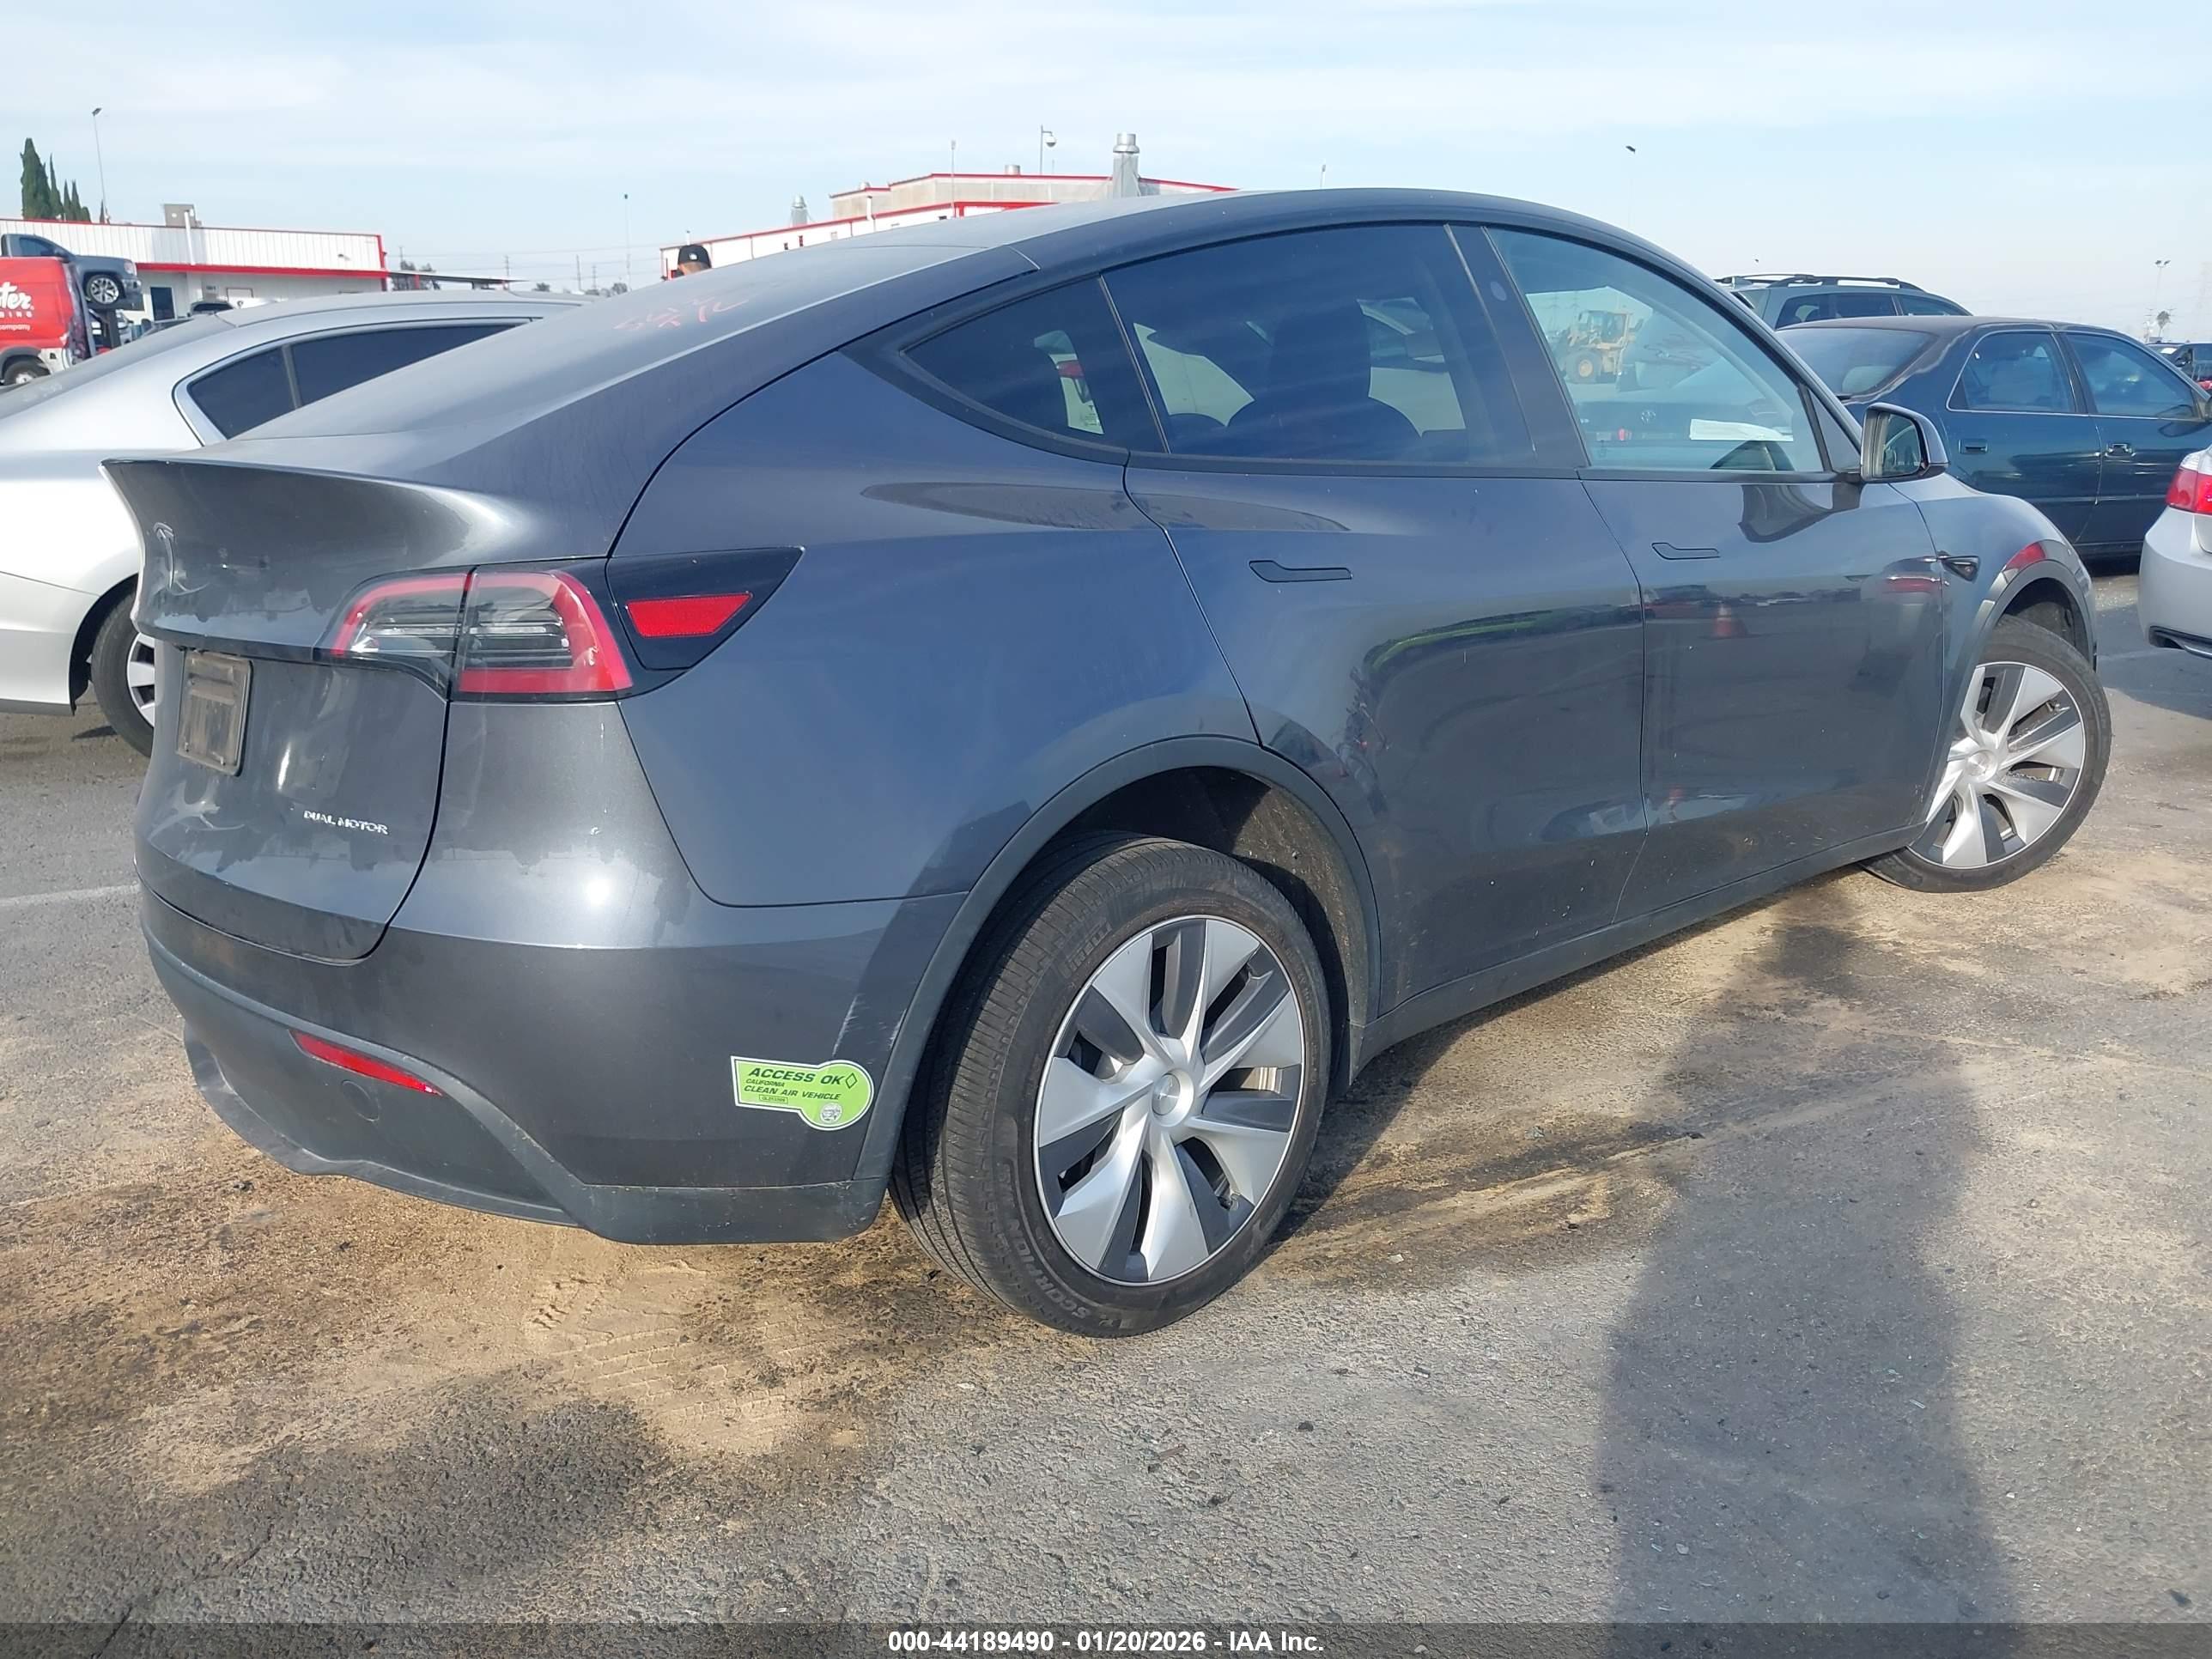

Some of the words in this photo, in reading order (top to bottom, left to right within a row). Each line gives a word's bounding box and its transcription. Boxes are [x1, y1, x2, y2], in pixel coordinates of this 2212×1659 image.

[0, 282, 32, 310] ter
[303, 810, 336, 825] DUAL
[337, 817, 388, 835] MOTOR
[748, 1067, 816, 1083] ACCESS
[820, 1074, 845, 1085] OK
[744, 1085, 778, 1095] CLEAN
[802, 1091, 842, 1100] VEHICLE
